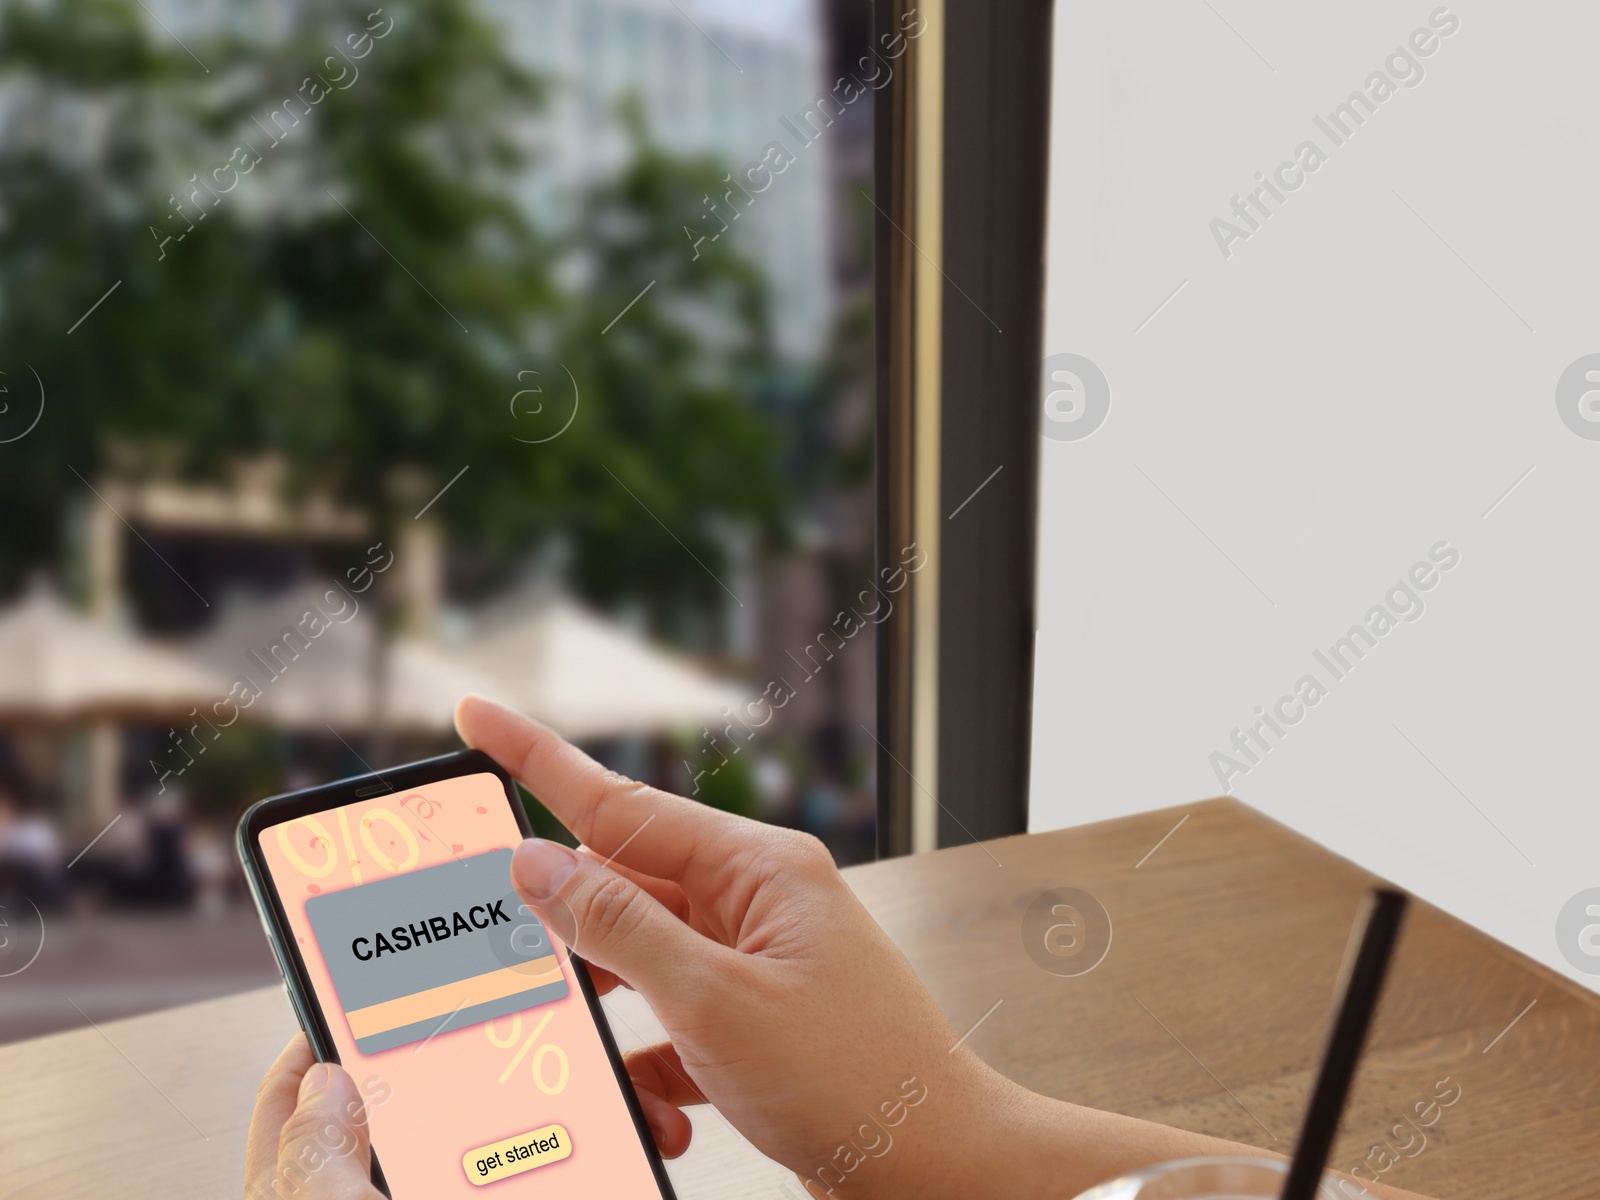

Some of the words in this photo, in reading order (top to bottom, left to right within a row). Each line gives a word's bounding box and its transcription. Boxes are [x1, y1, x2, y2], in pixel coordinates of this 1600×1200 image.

[352, 899, 511, 961] CASHBACK
[476, 1151, 503, 1176] get
[505, 1132, 560, 1163] started
